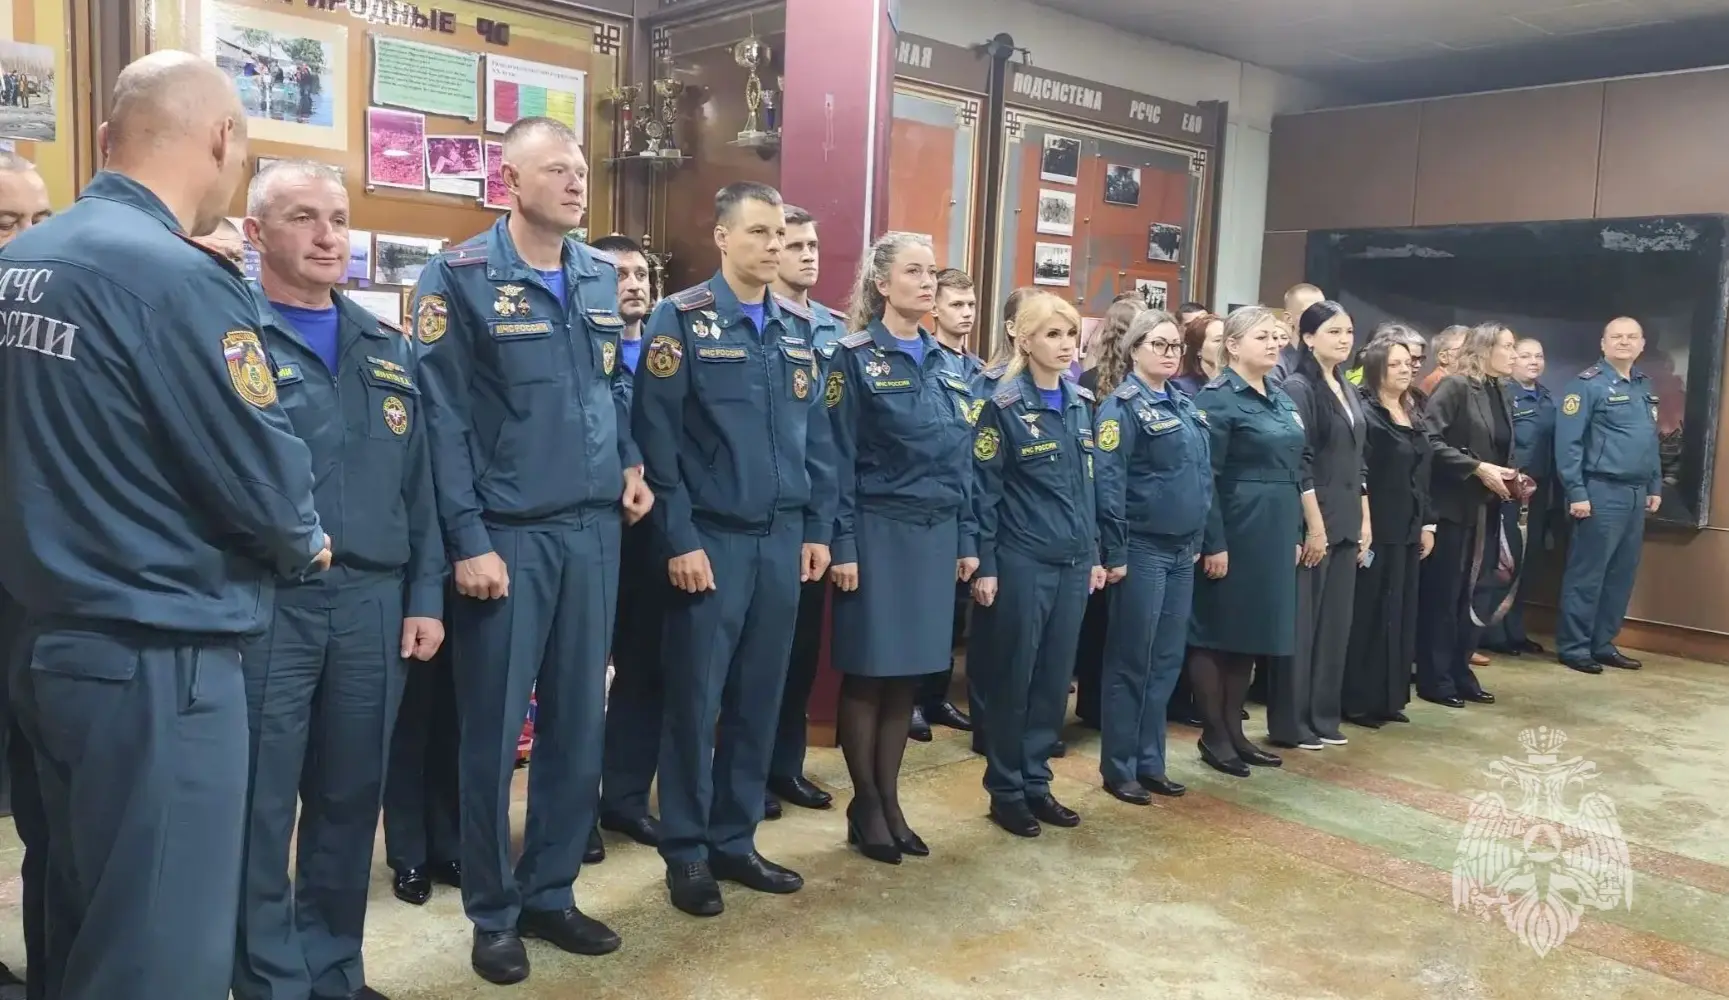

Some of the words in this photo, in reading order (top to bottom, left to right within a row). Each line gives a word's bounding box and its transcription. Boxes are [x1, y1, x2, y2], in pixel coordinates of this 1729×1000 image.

[895, 40, 933, 69] НАЯ
[1013, 72, 1103, 111] ПОДСИСТЕМА
[1129, 100, 1162, 124] РСЧС
[1181, 112, 1203, 134] ЕАО
